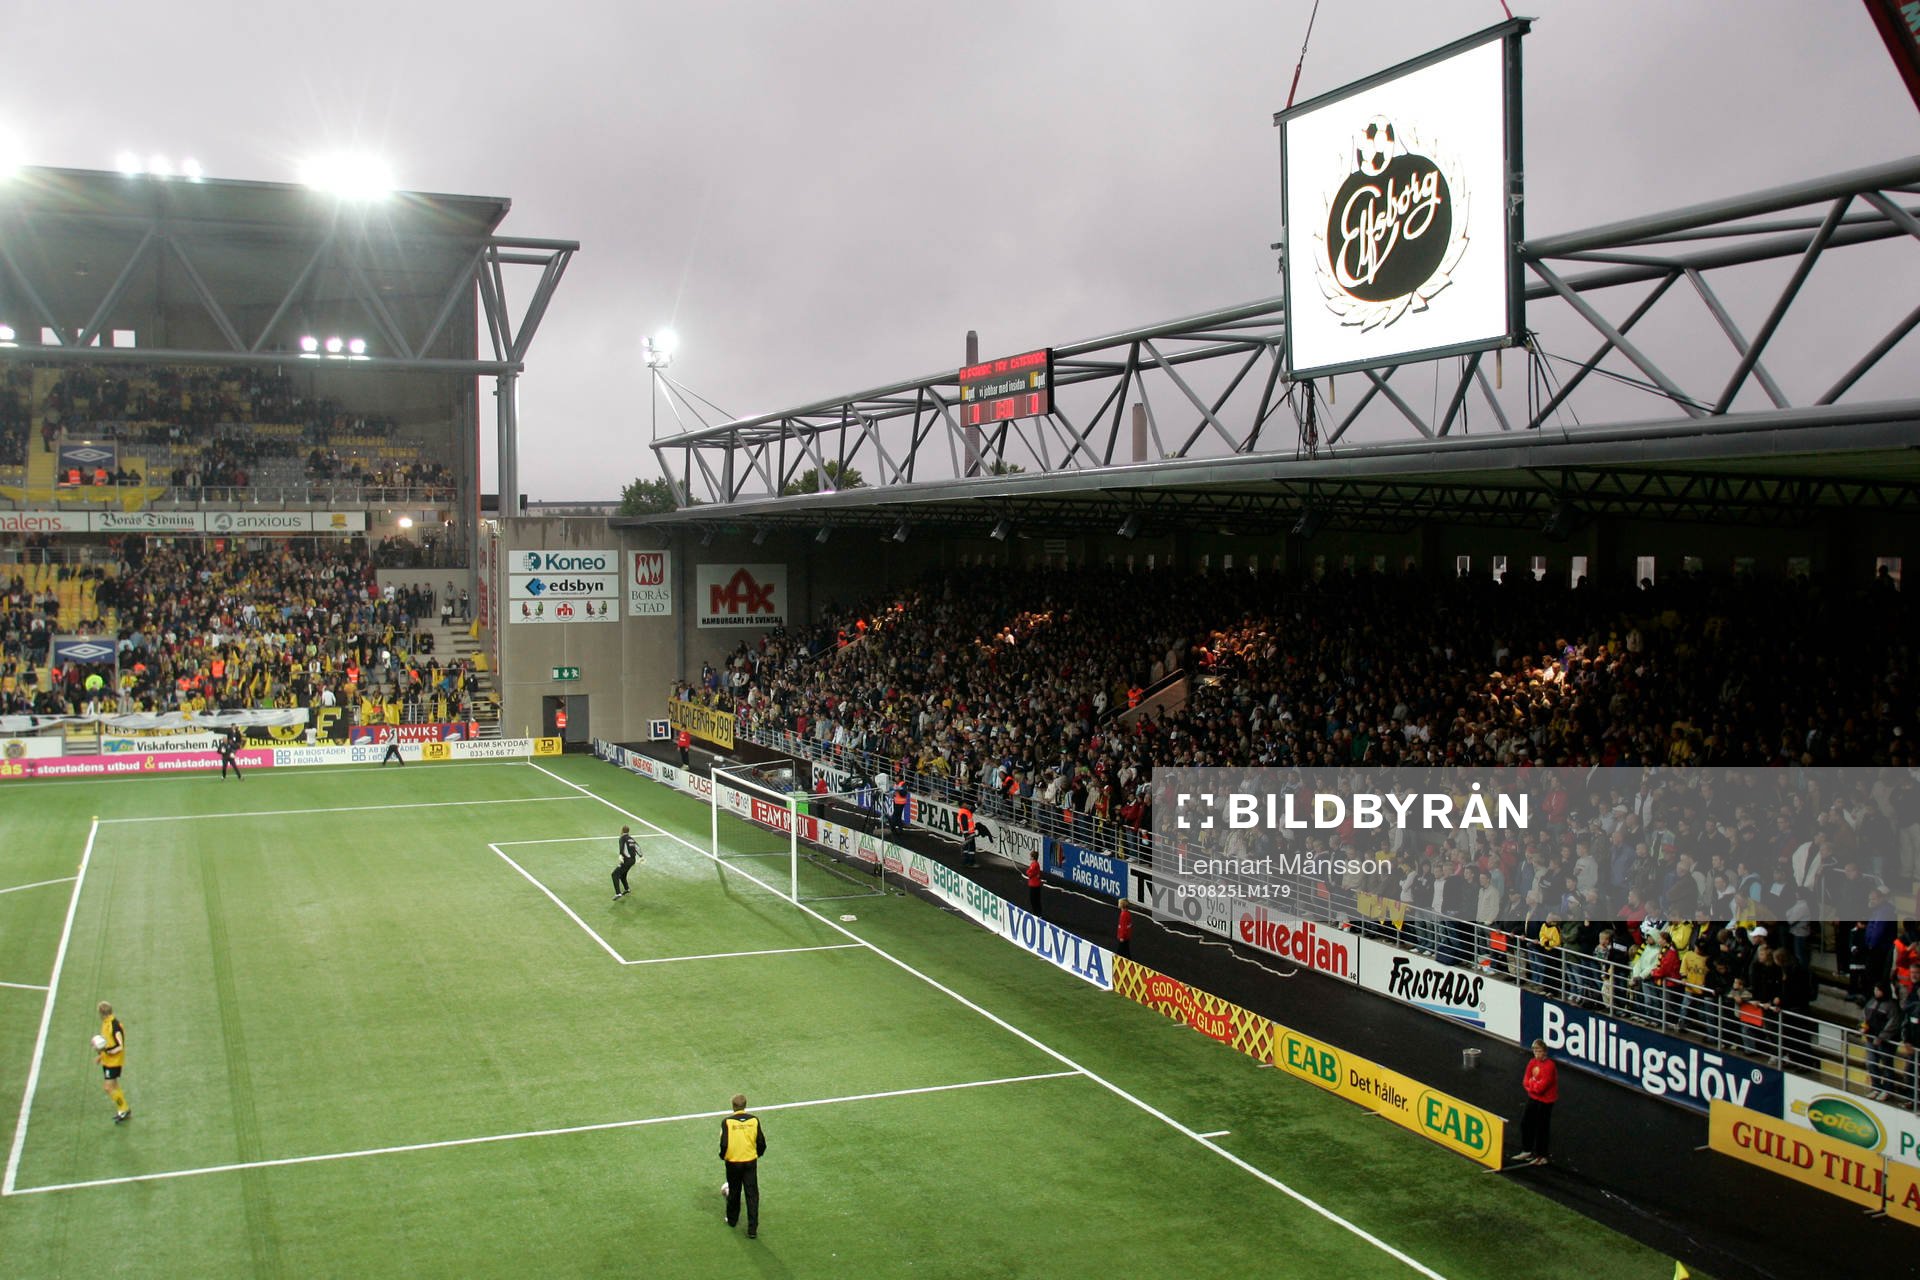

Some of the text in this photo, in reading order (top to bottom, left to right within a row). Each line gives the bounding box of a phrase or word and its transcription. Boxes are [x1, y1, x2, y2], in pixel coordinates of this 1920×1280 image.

[1336, 170, 1441, 288] Elfsborg
[143, 512, 194, 527] Tidning
[237, 515, 302, 527] anxious
[546, 553, 606, 570] Koneo
[550, 580, 604, 594] edsbyn
[709, 567, 775, 614] MAX
[636, 603, 664, 613] STAD
[38, 763, 104, 774] storstadens
[107, 761, 140, 770] utbud
[144, 755, 155, 769] &
[756, 802, 782, 827] TEAM
[1072, 862, 1092, 886] FÄRG
[1093, 877, 1100, 889] &
[1101, 878, 1121, 896] PUTS
[1079, 850, 1114, 874] CAPAROL
[1206, 914, 1227, 931] com
[1006, 902, 1109, 987] VOLVIA
[1389, 956, 1485, 1008] FRISTADS
[1152, 981, 1225, 1037] GOD OCH GLAD
[1287, 1036, 1337, 1083] EAB
[1350, 1069, 1409, 1112] Det håller.
[1425, 1095, 1484, 1151] EAB
[1732, 1120, 1815, 1169] GULD
[1820, 1149, 1895, 1203] TILL
